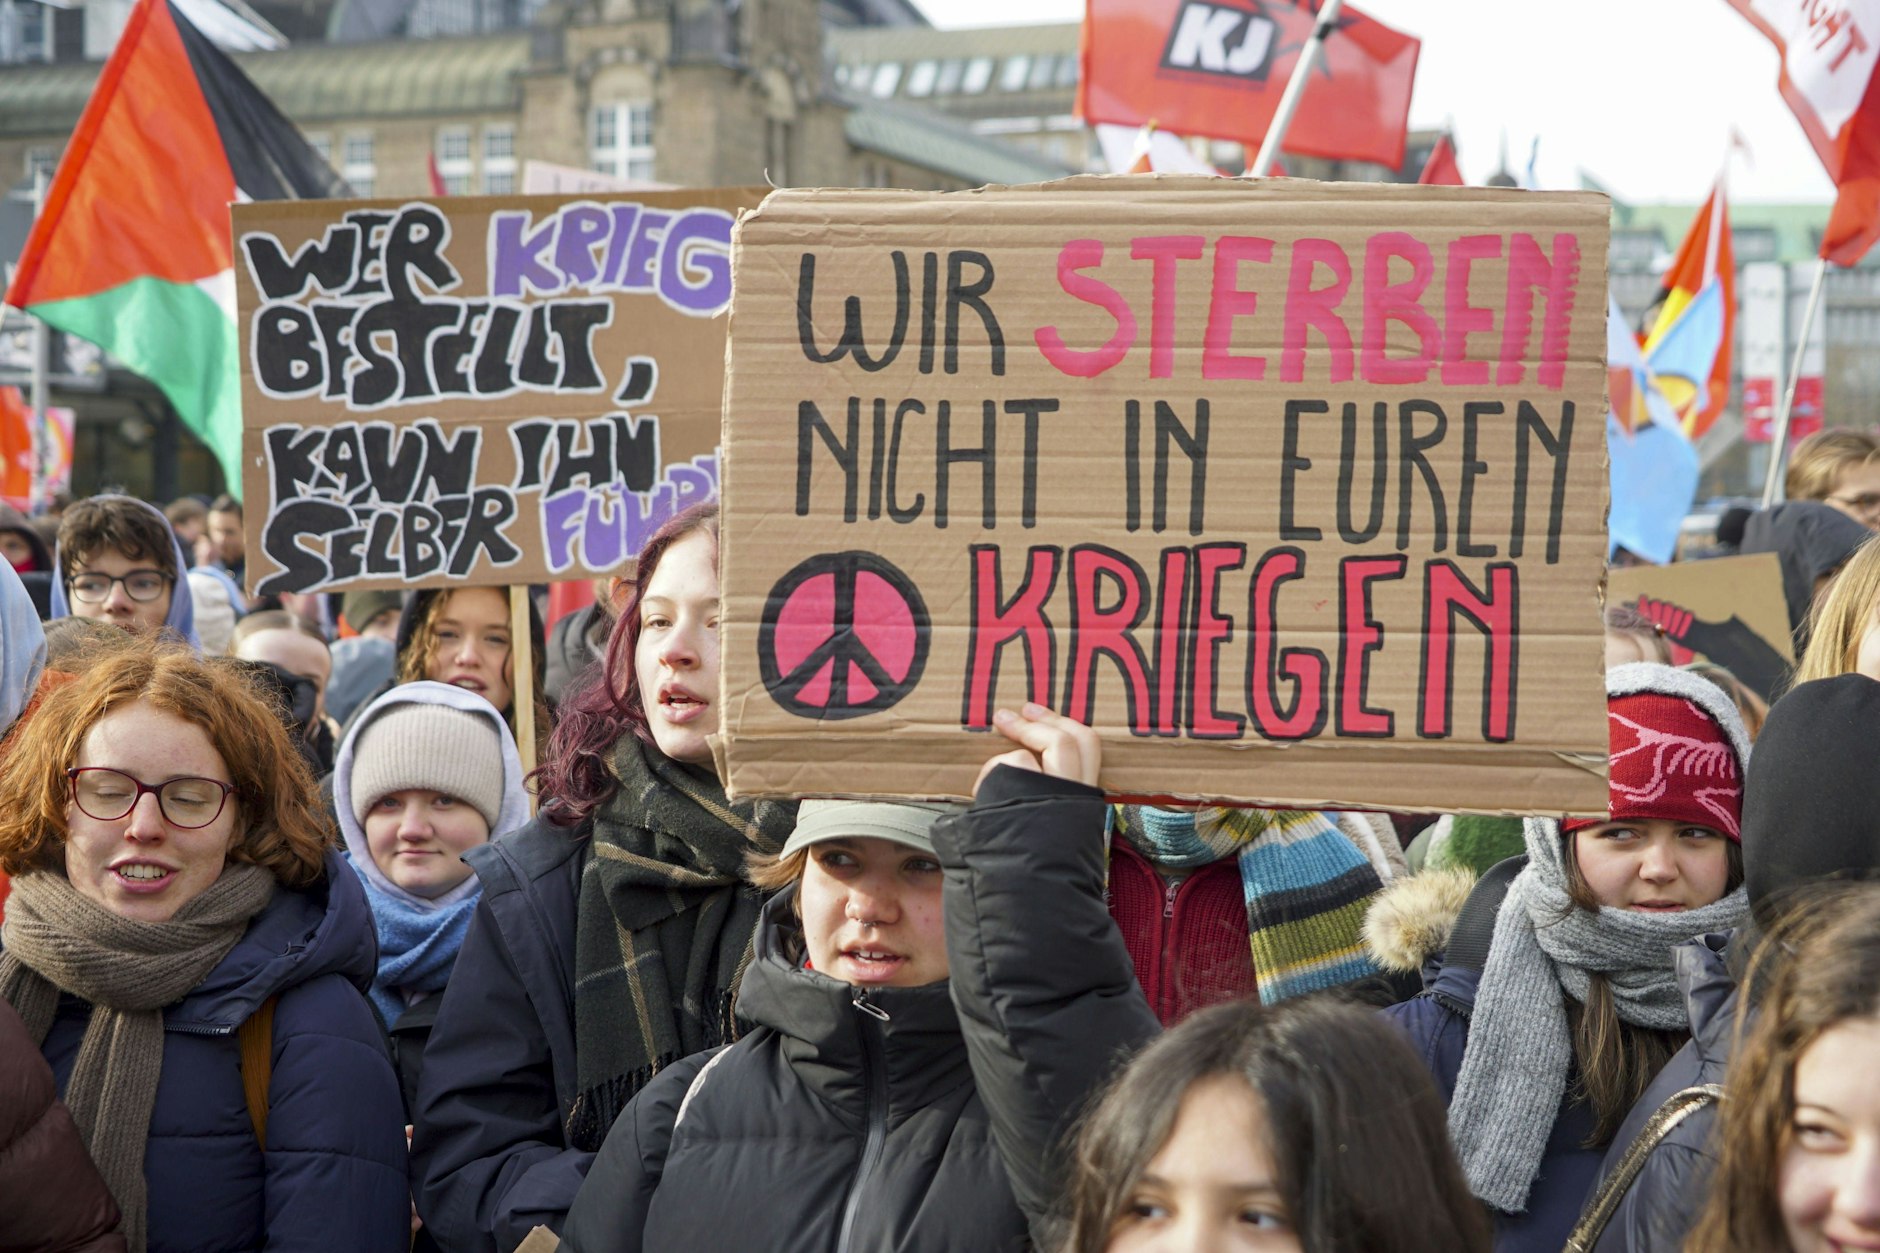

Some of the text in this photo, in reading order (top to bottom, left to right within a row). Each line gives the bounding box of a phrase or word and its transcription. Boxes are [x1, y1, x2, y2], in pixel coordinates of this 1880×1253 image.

[1167, 3, 1275, 75] KJ
[1800, 0, 1869, 74] GHT
[241, 203, 734, 316] WER KRIEG
[797, 232, 1582, 389] WIR STERBEN
[263, 412, 661, 510] KANN IHN
[795, 396, 1577, 564] NICHT IN EUREN
[253, 486, 522, 597] SELBER
[960, 541, 1520, 742] KRIEGEN
